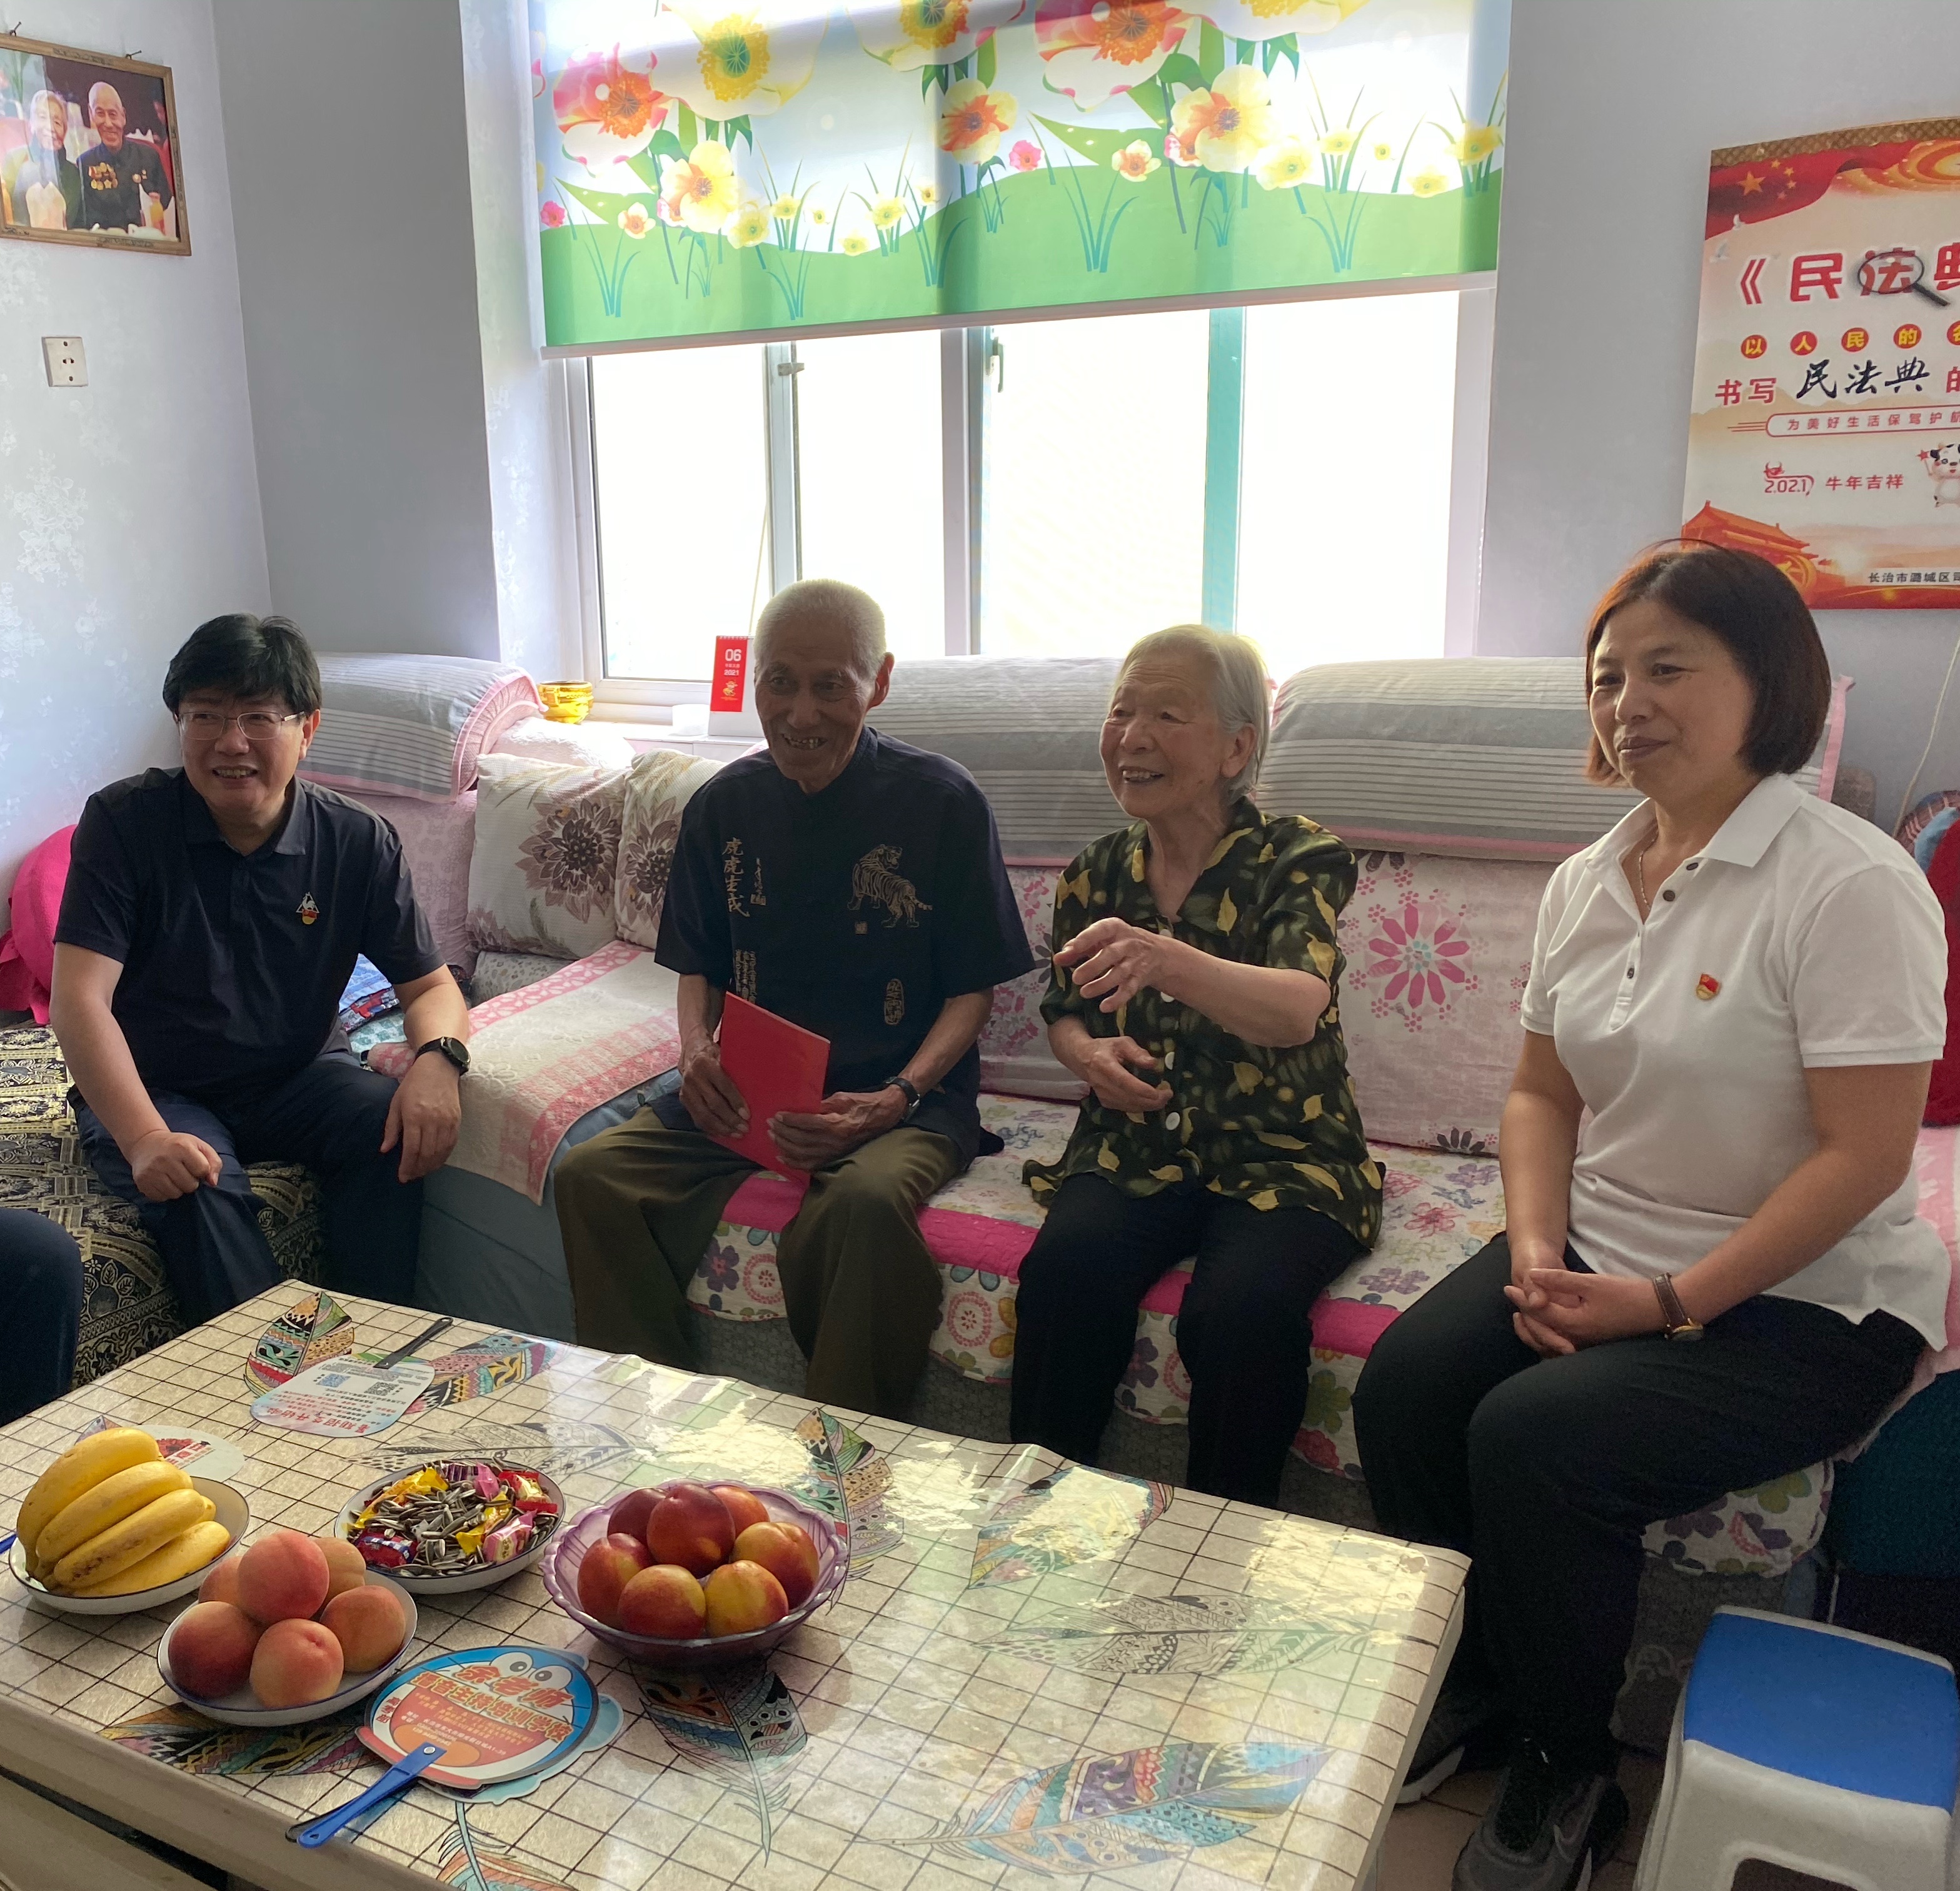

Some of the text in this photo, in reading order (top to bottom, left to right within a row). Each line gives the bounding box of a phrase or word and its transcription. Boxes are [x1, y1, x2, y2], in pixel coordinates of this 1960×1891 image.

[1715, 378, 1777, 406] 书写
[1796, 356, 1931, 399] 民法典
[1826, 473, 1904, 491] 牛年吉祥
[725, 648, 742, 662] 06
[410, 1670, 574, 1743] 播音主持培训学校
